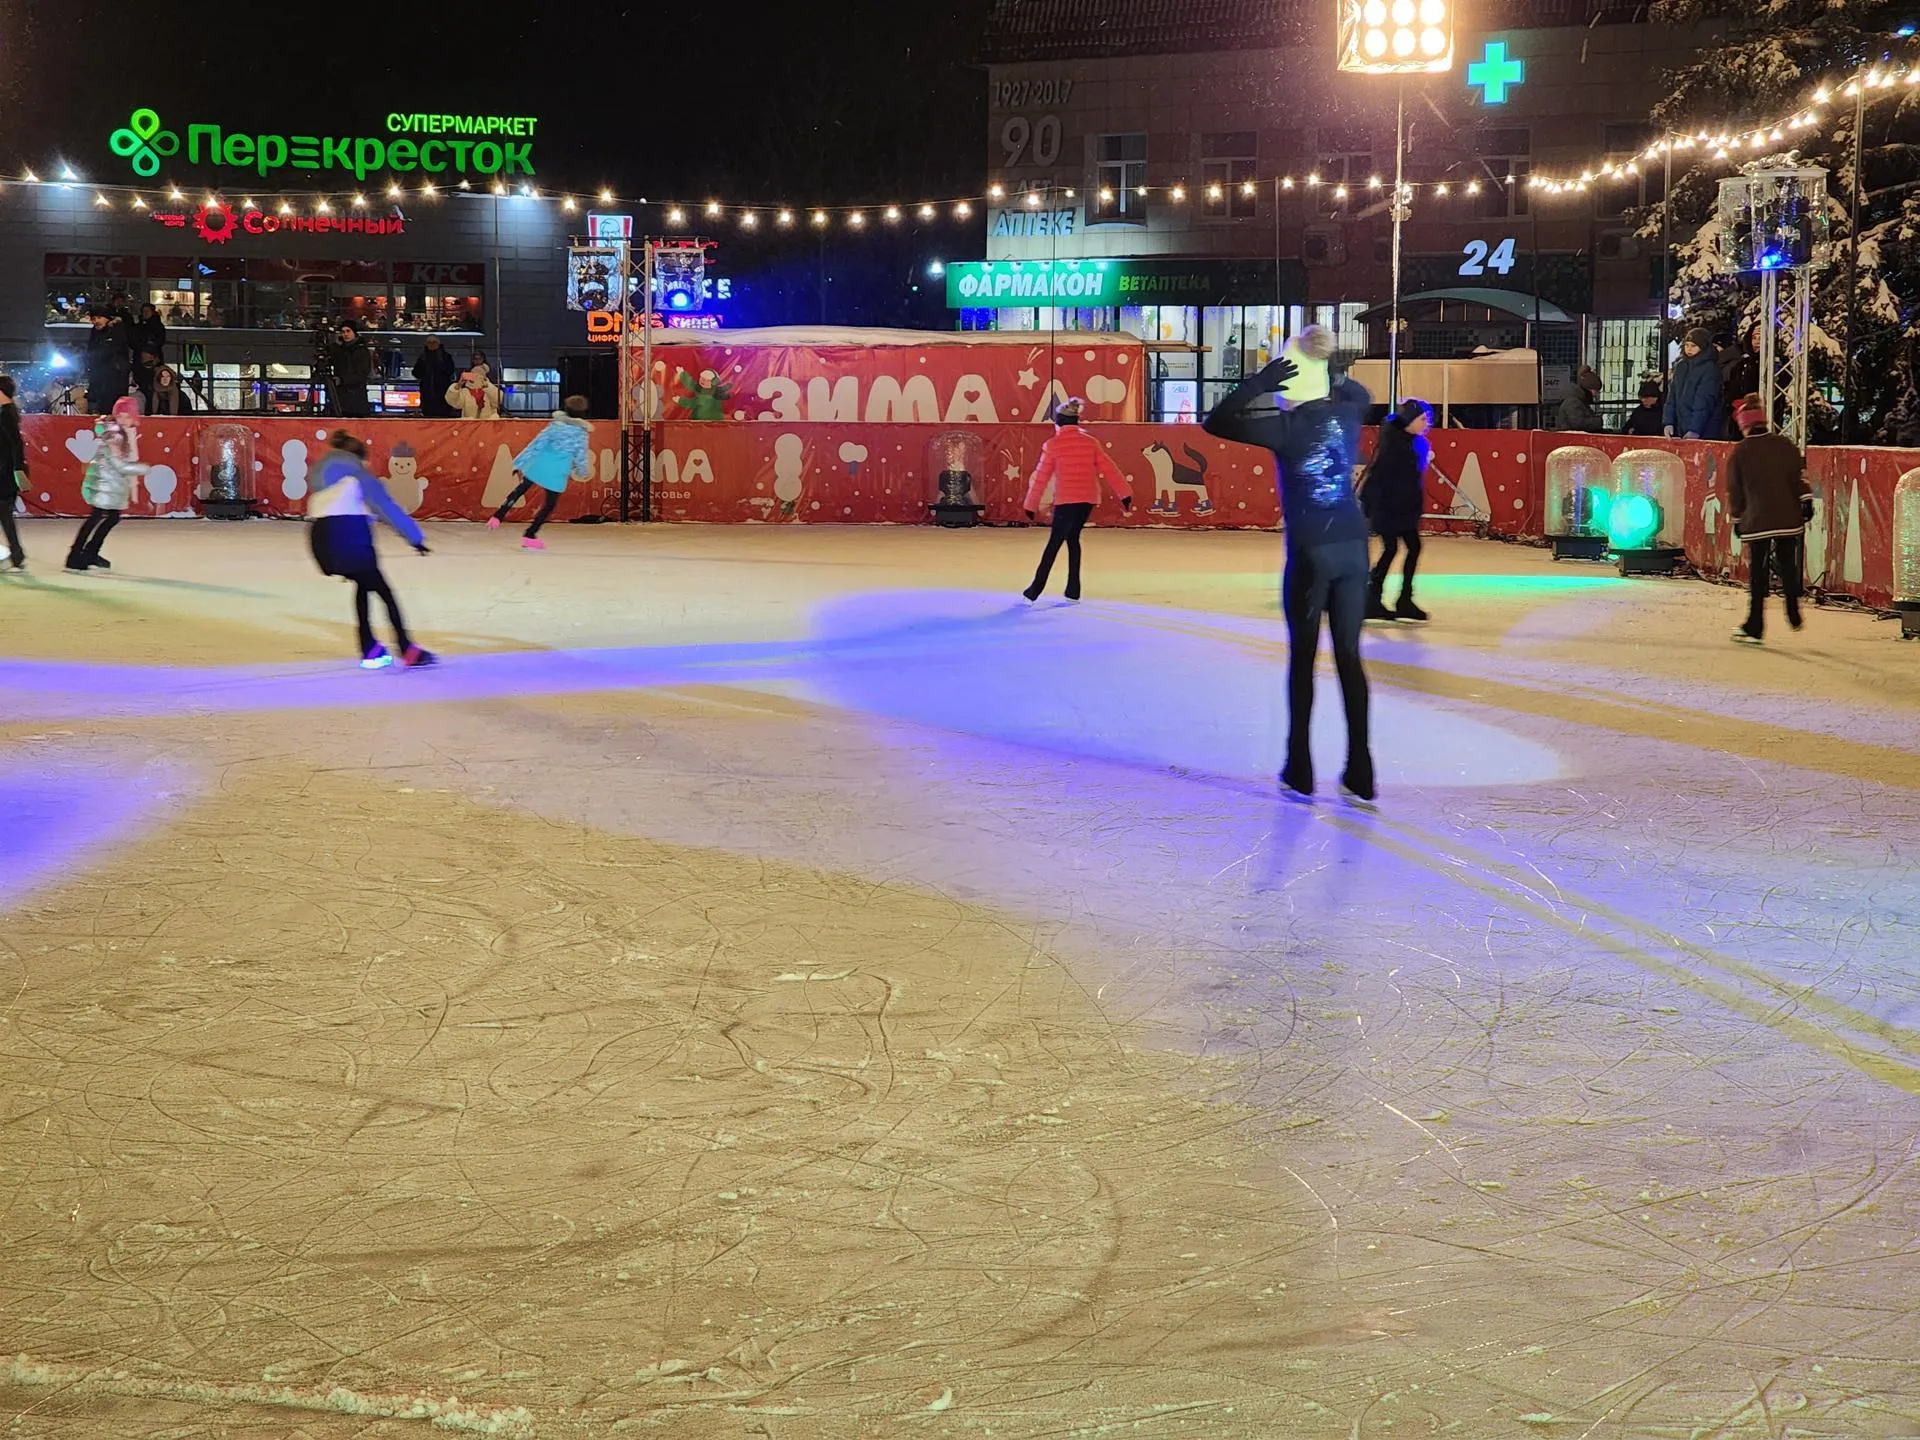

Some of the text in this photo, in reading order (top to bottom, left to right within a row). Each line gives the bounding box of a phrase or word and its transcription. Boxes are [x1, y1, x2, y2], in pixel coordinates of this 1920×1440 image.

[387, 112, 538, 136] СУПЕРМАРКЕТ
[1001, 115, 1062, 168] 90
[992, 211, 1073, 237] АПТЕКЕ
[64, 255, 124, 277] KFC
[1458, 238, 1516, 276] 24
[410, 263, 470, 283] KFC
[958, 273, 1211, 298] ФАРМАКОН ВЕТАПТЕКА
[757, 373, 1000, 423] ЗИМА
